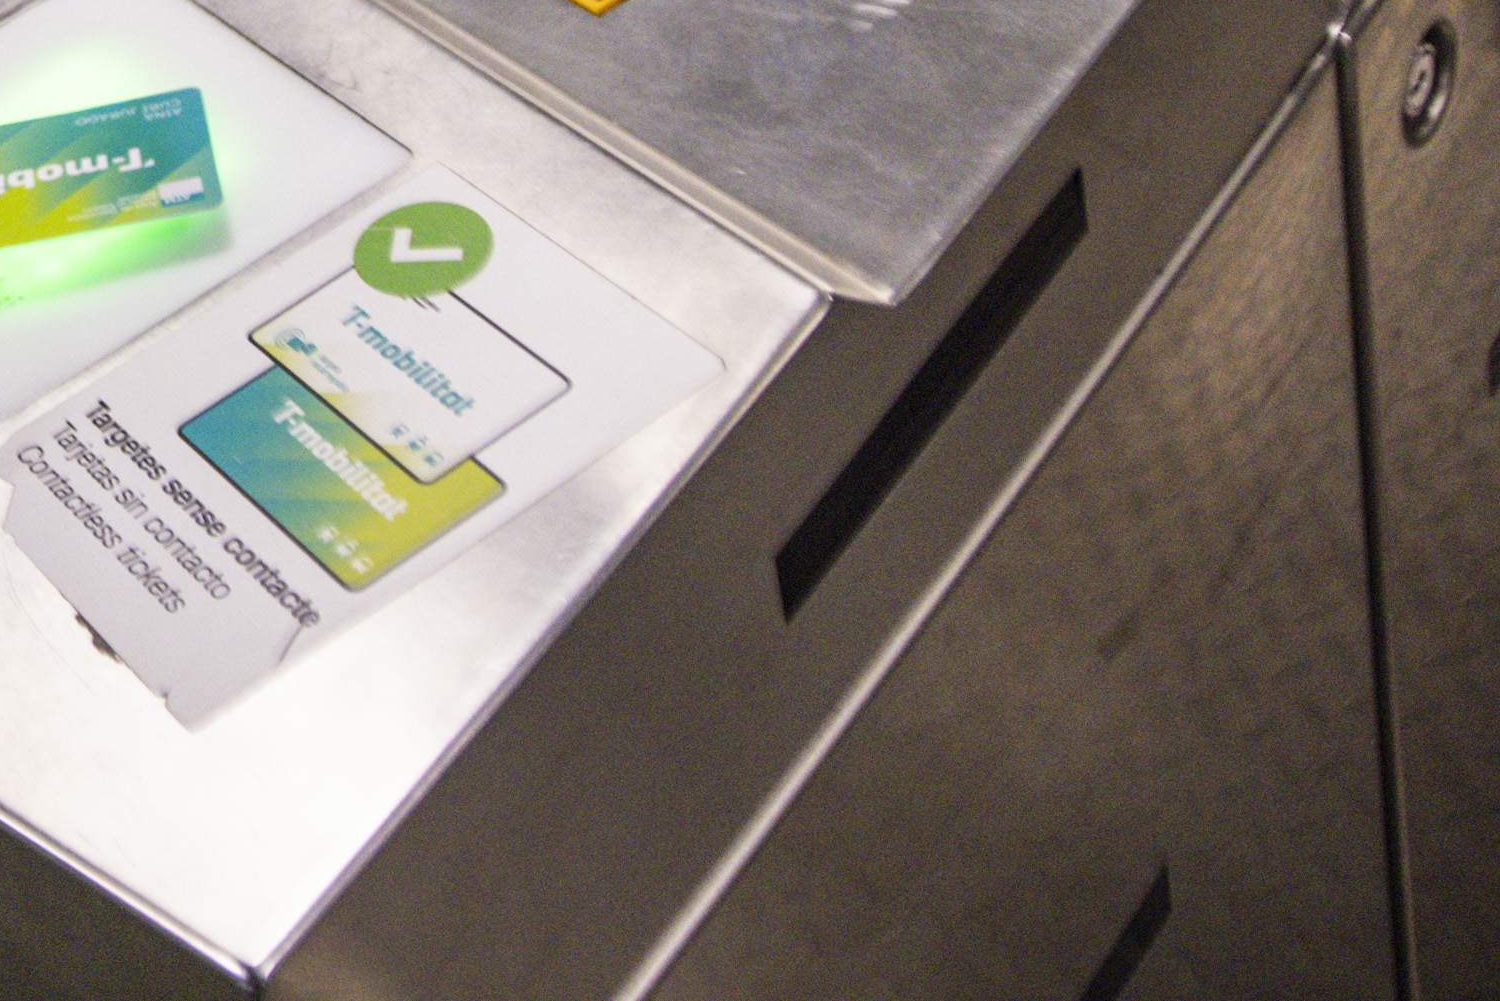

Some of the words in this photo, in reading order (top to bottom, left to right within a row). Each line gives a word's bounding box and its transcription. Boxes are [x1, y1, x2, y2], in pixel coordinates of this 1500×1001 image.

[342, 304, 476, 417] T-mobilitat
[16, 445, 124, 550] Contactless
[116, 544, 187, 615] tickets
[52, 420, 120, 492] Tarjetas
[114, 486, 150, 521] sin
[143, 516, 231, 601] contacto
[85, 399, 168, 481] Targetes
[161, 478, 227, 538] sense
[223, 536, 322, 628] contacte
[271, 399, 409, 522] T-mobilitat
